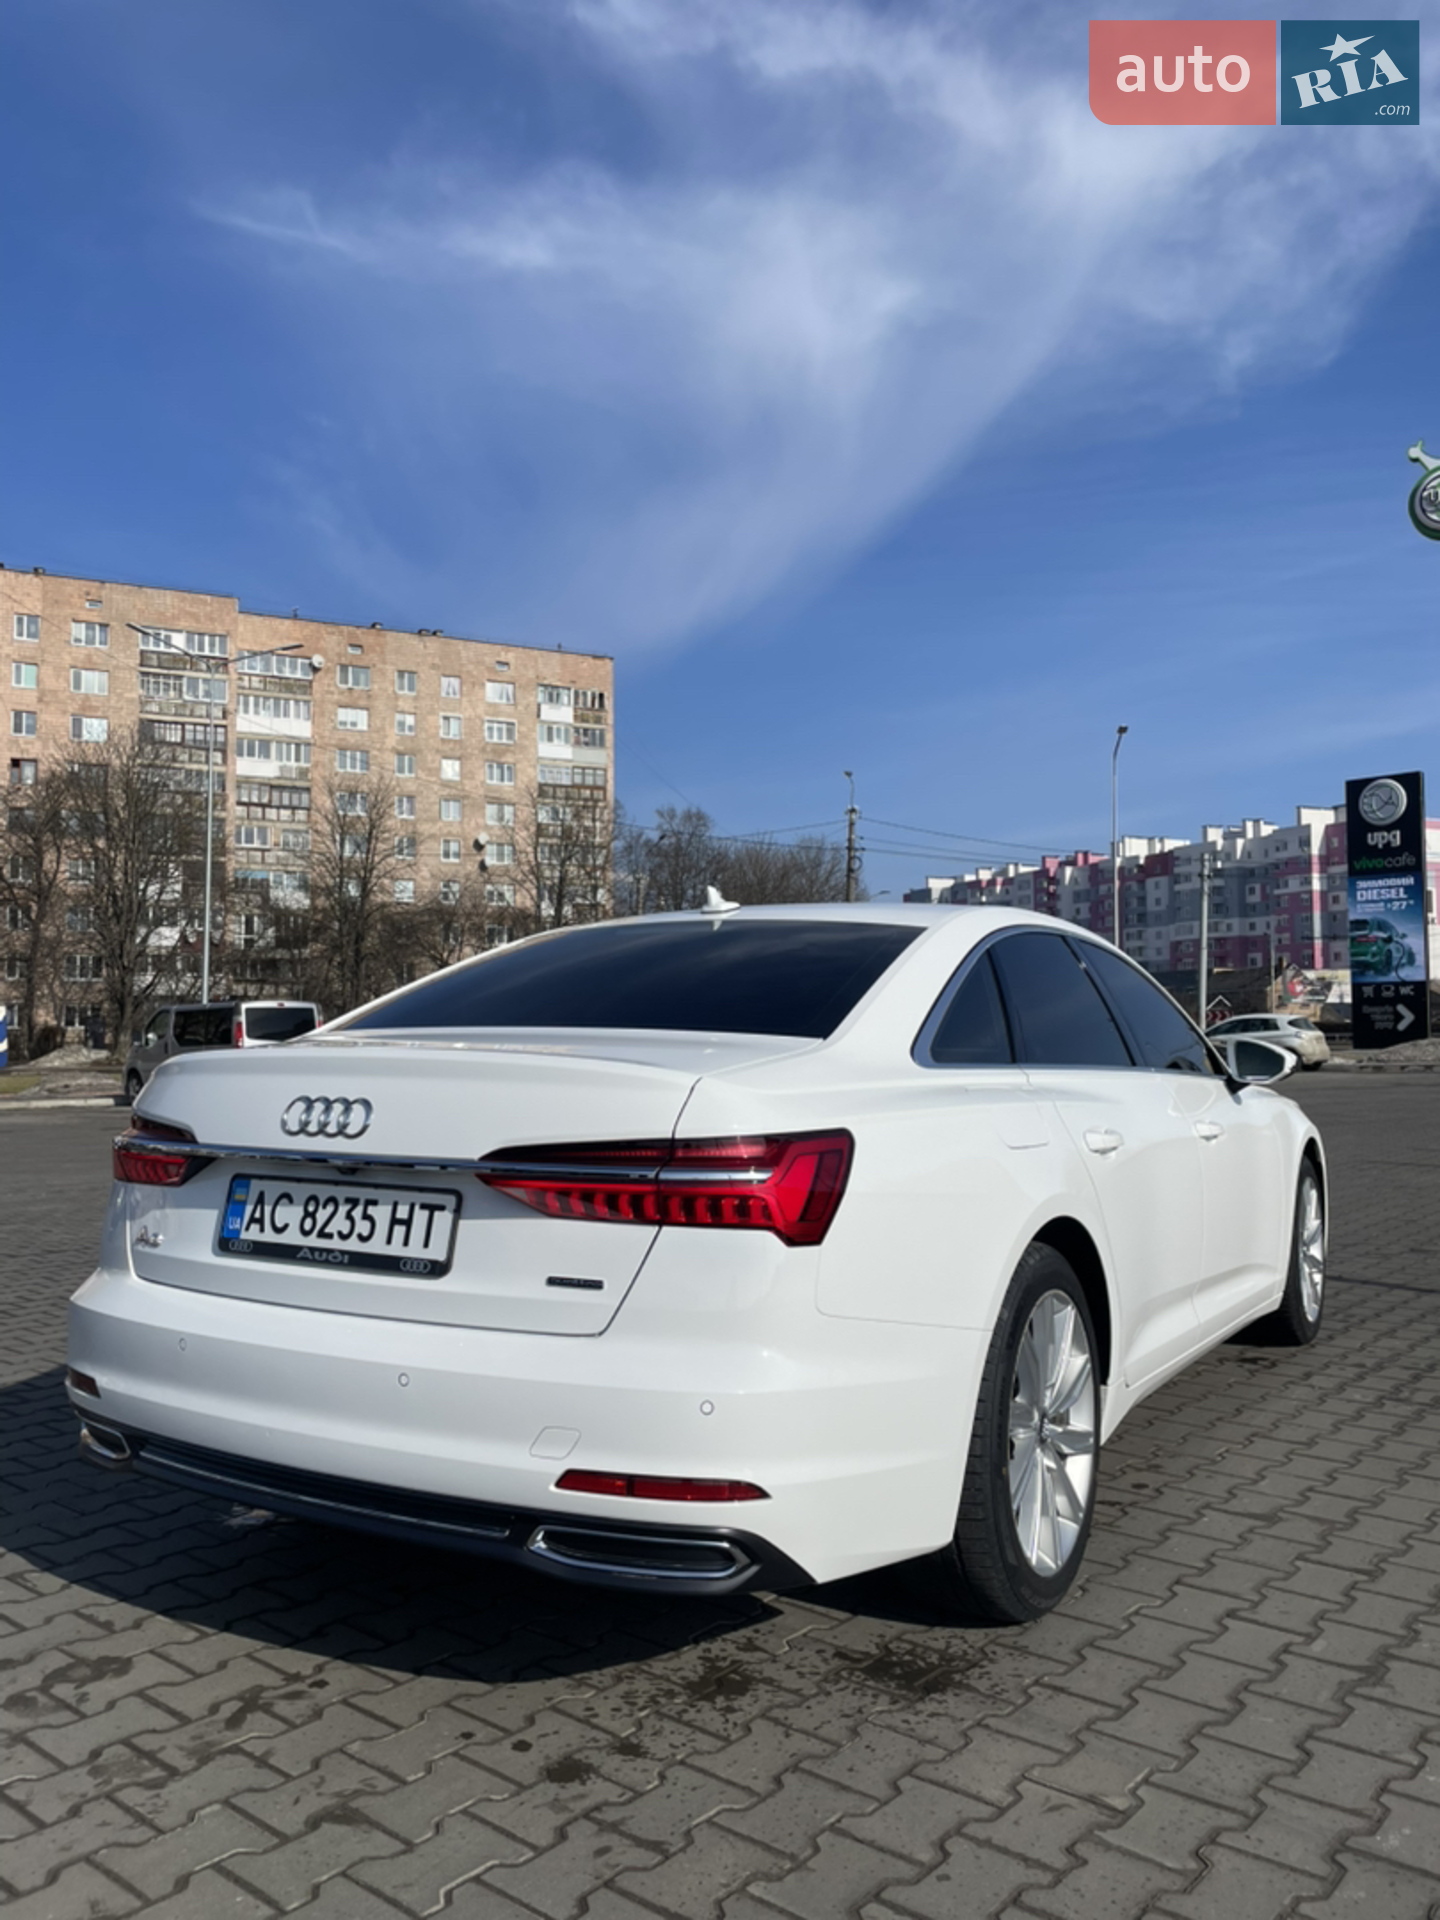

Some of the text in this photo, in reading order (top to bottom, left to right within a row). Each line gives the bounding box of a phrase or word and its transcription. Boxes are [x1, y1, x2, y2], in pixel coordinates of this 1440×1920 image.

[1366, 829, 1401, 849] upg
[1356, 887, 1408, 902] DIESEL
[228, 1216, 242, 1230] UA
[244, 1190, 447, 1249] AC 8235 HT
